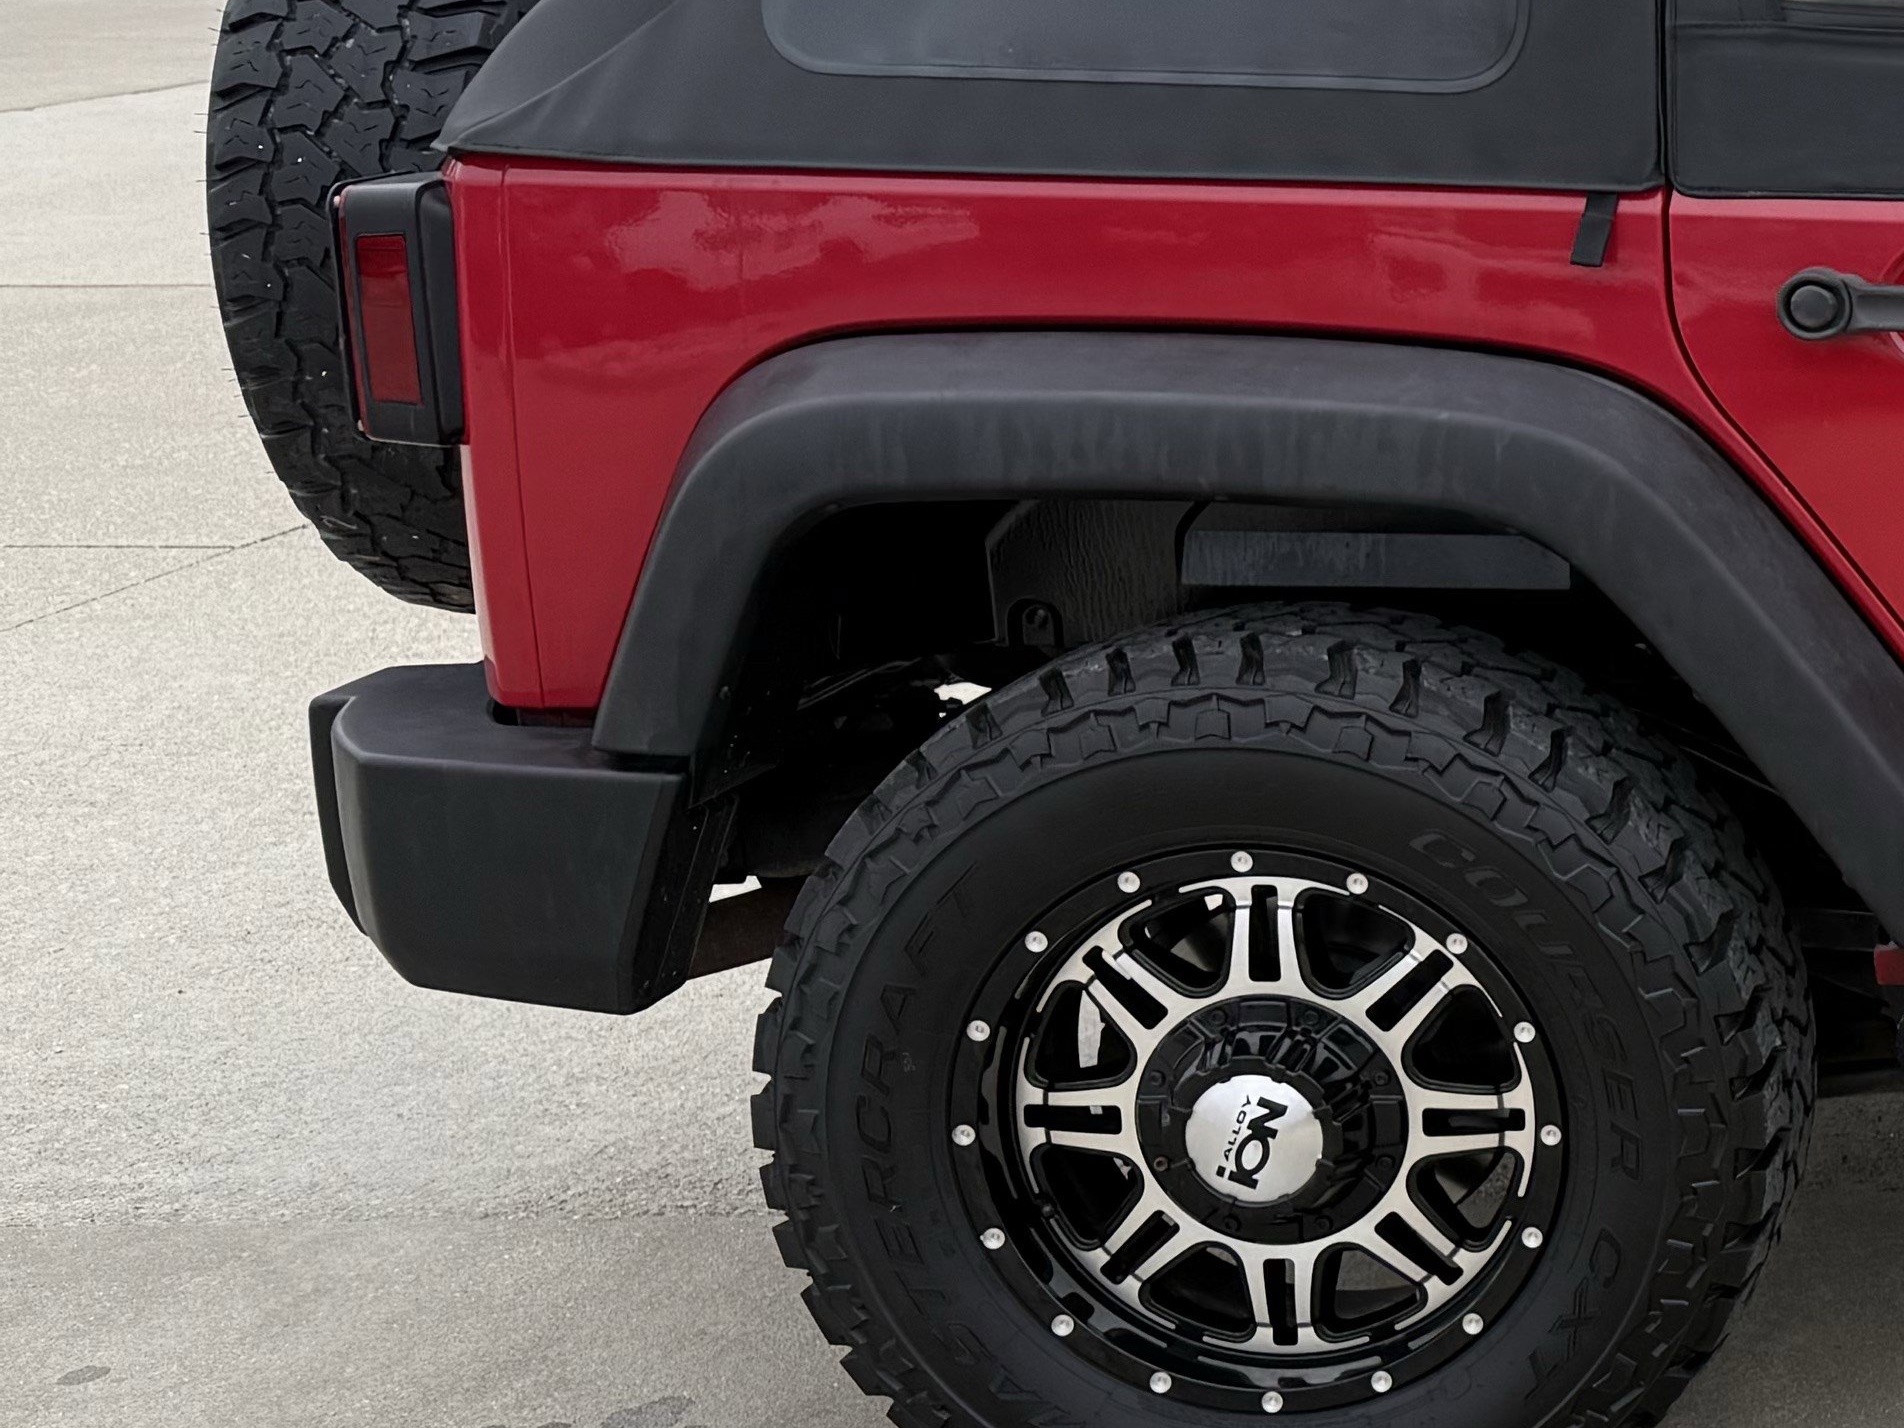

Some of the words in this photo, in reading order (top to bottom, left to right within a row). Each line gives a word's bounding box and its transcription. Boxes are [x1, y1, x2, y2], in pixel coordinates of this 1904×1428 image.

[1408, 828, 1645, 1181] COURSER
[1223, 1094, 1252, 1162] ALLOY
[1524, 1225, 1623, 1403] CXT
